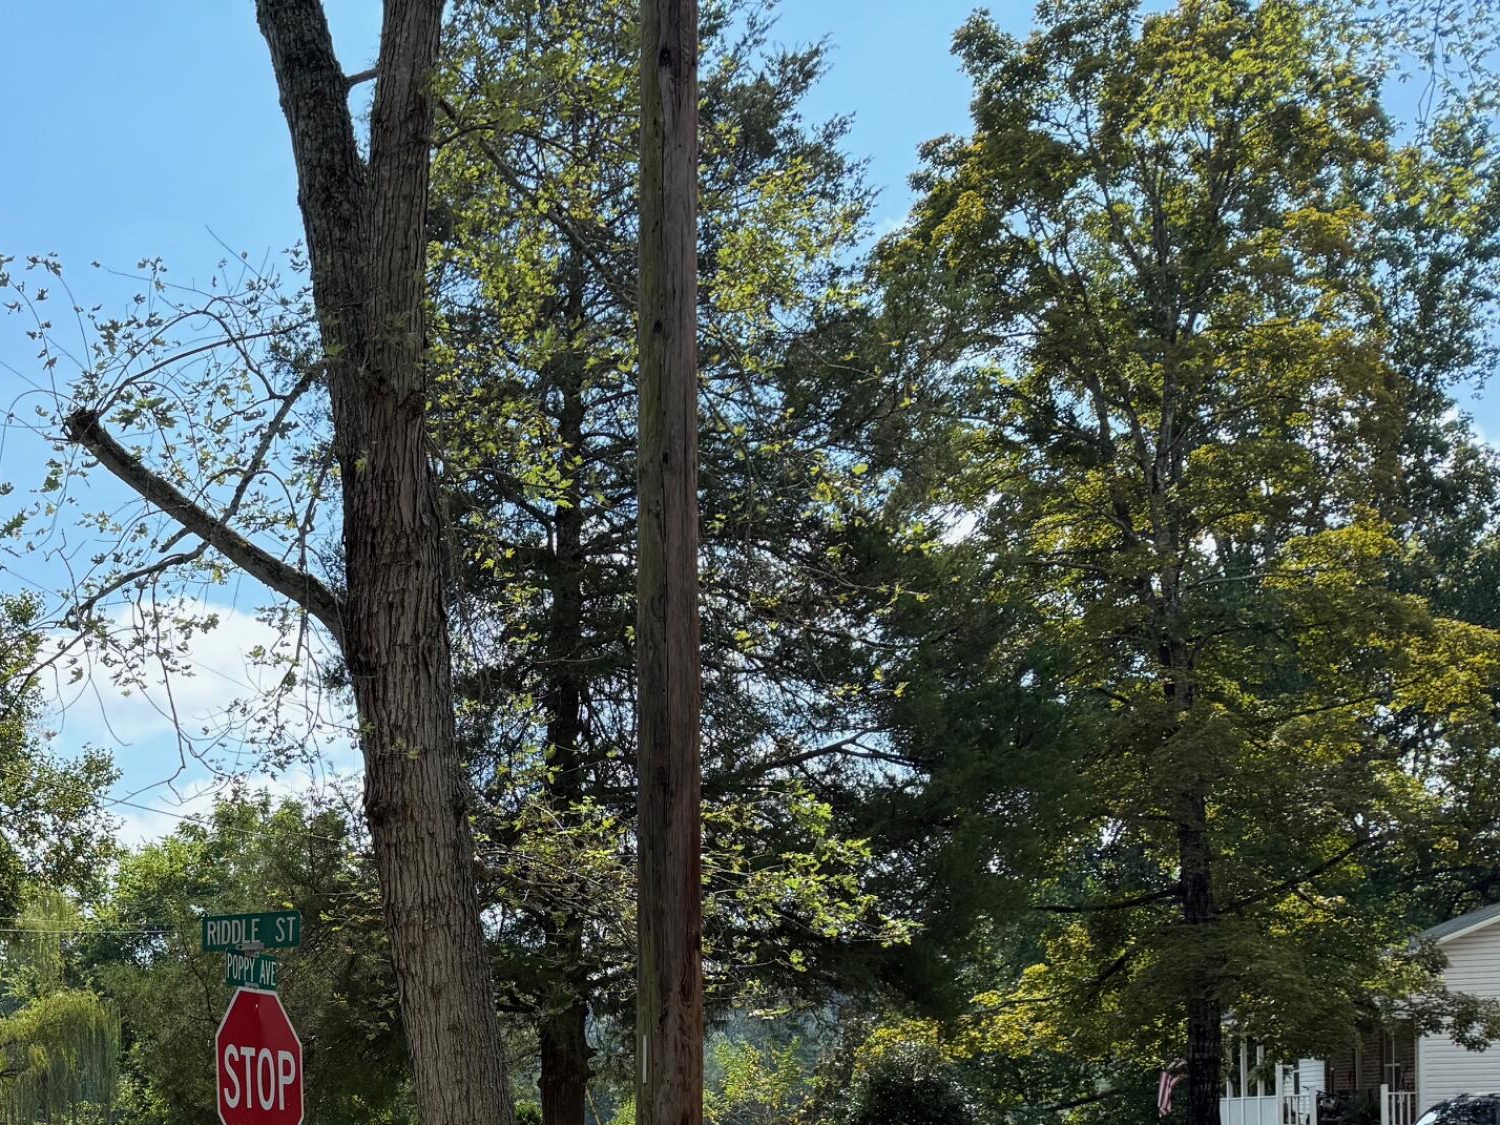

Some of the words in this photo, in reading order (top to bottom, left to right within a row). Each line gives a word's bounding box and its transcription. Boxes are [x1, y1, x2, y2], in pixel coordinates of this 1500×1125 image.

[207, 918, 260, 945] RIDDLE
[275, 916, 296, 942] ST
[227, 953, 255, 982] POPPY
[260, 959, 276, 986] AVE
[224, 1043, 296, 1111] STOP
